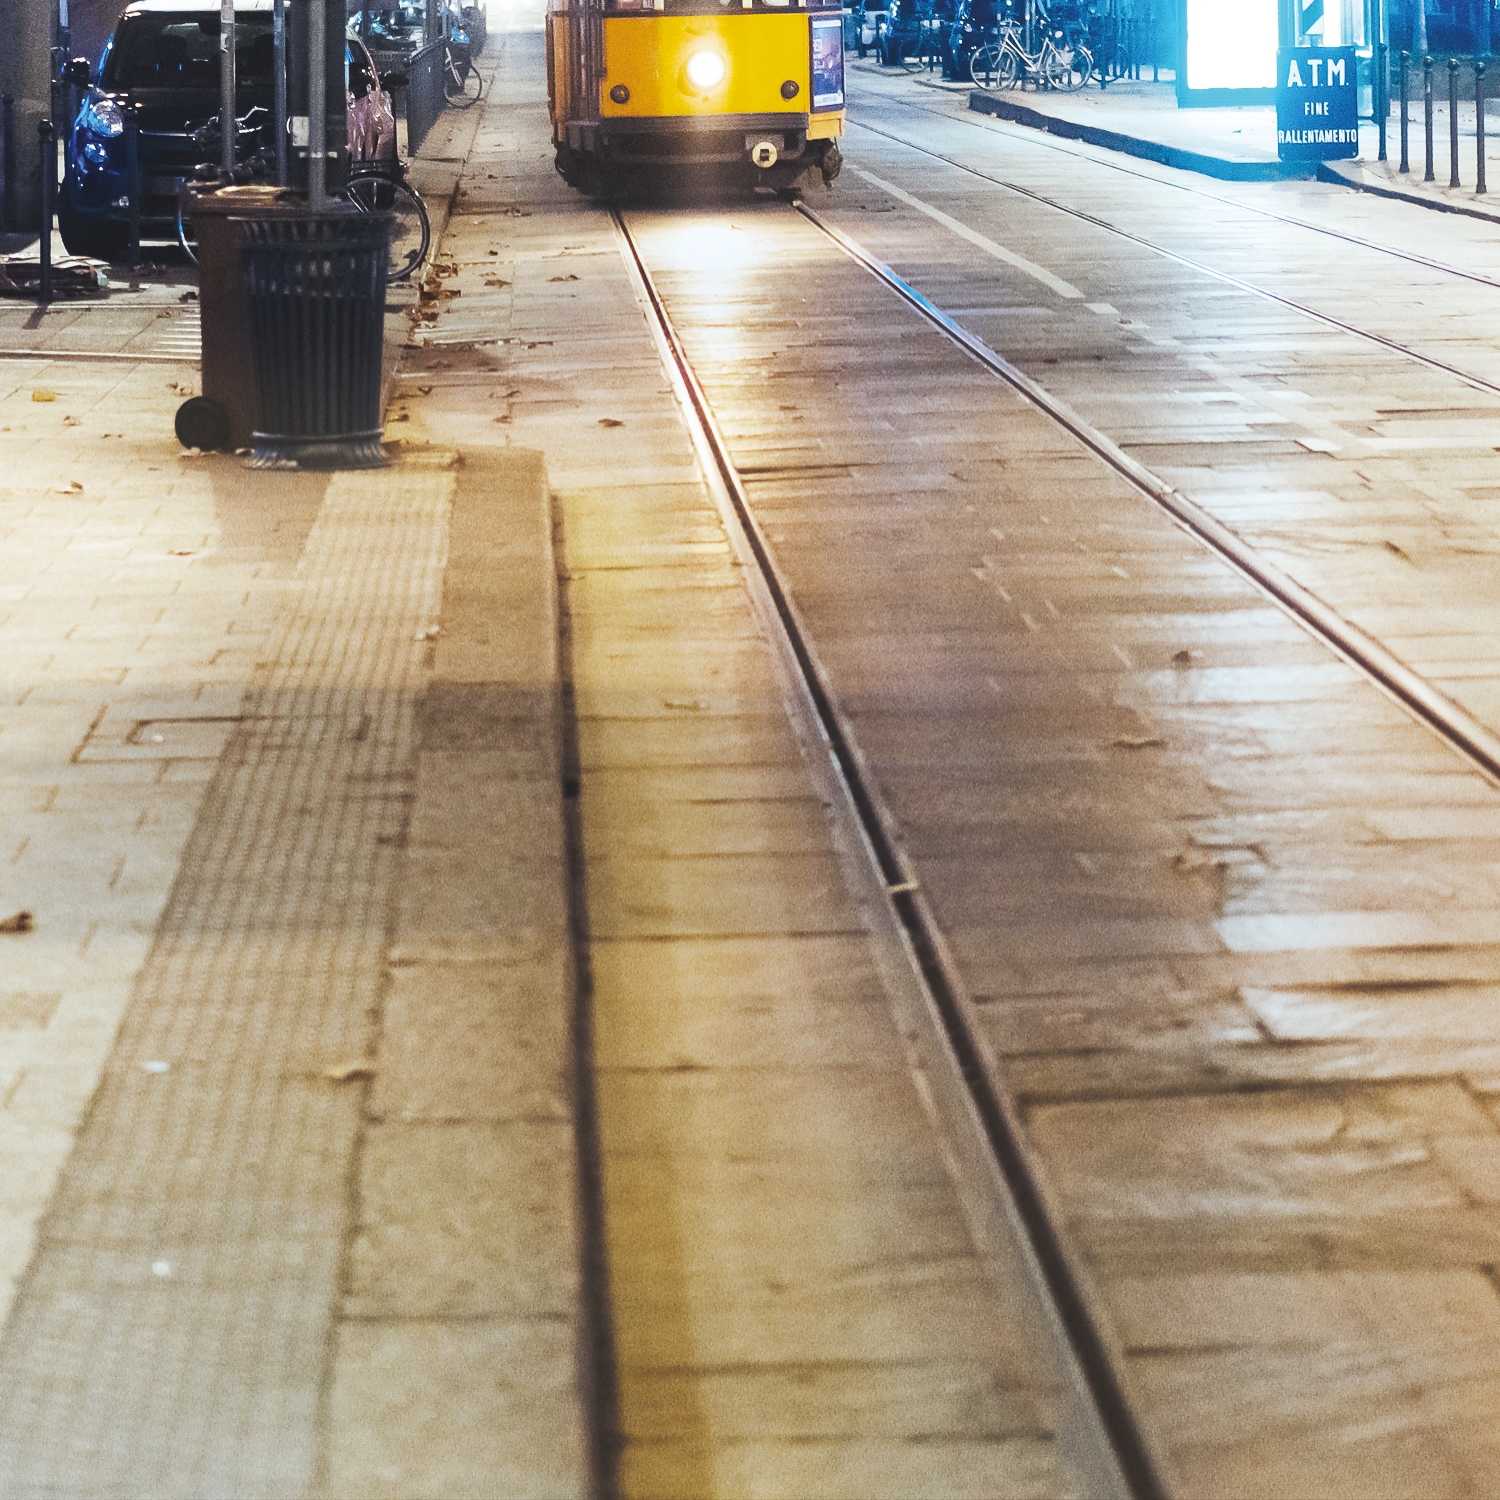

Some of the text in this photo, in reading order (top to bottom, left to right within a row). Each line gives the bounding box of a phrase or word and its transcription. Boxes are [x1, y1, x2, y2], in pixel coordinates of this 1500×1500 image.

[1287, 58, 1349, 88] A.T.M.
[1304, 101, 1329, 115] FINE
[1278, 128, 1357, 143] RALLENTAMENTO
